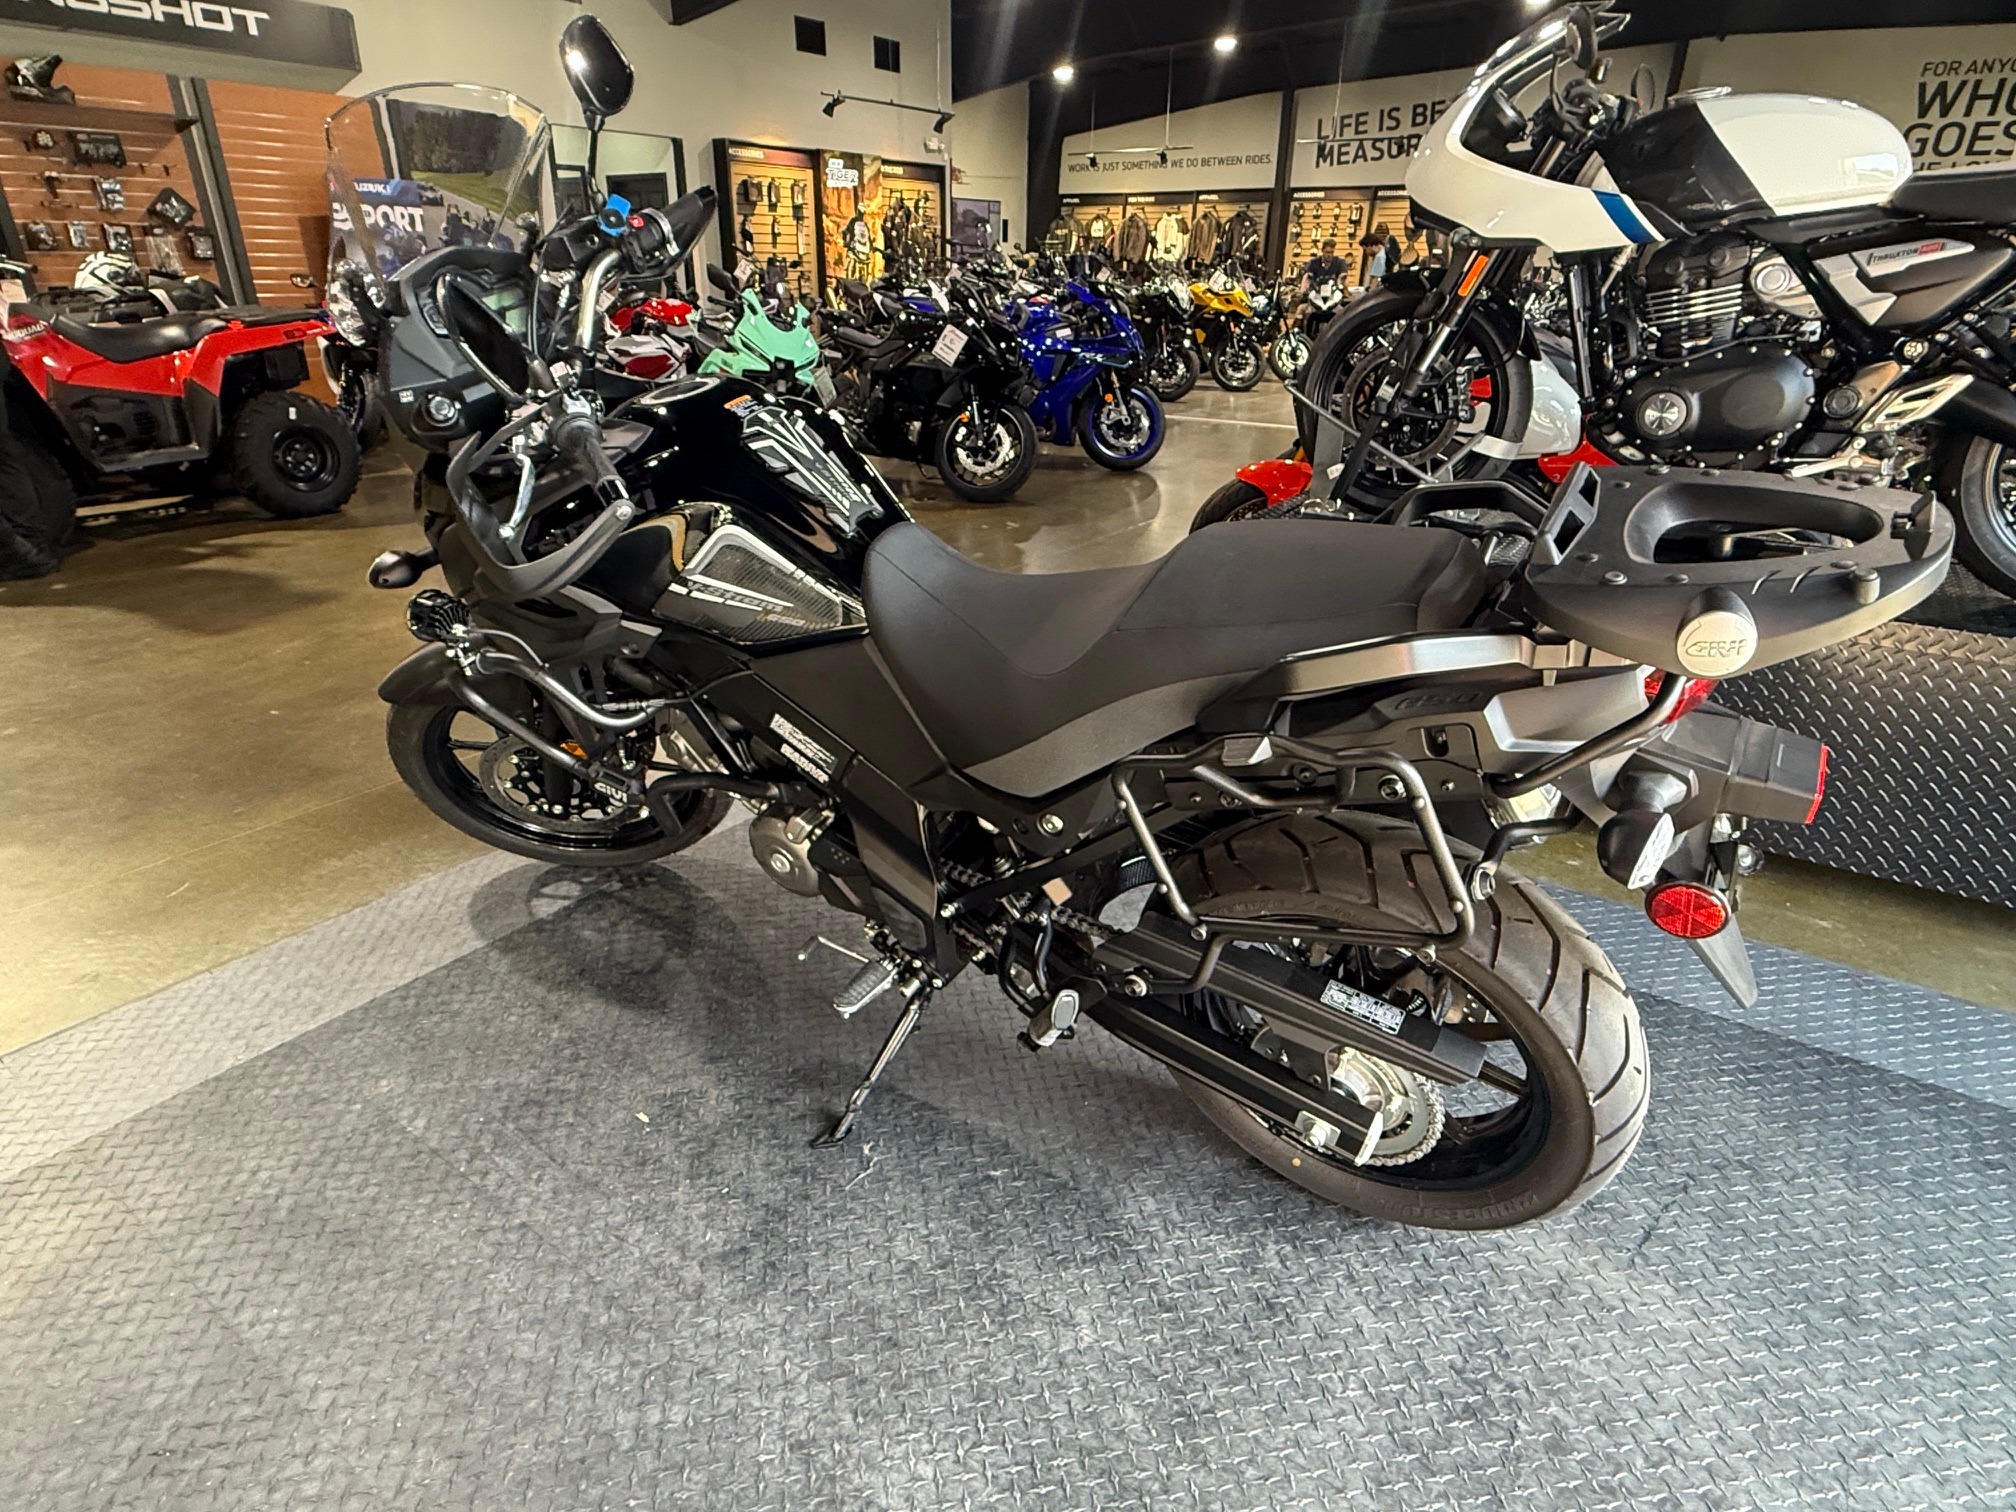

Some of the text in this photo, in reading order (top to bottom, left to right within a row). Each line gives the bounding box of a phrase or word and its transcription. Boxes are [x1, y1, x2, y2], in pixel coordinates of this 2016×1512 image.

[46, 0, 270, 36] SHOT
[1921, 60, 1962, 77] FOR
[1317, 99, 1446, 140] LIFE IS BE
[1903, 119, 2016, 158] GOES
[1315, 133, 1423, 168] MEASUR
[1068, 163, 1090, 172] WORK
[1102, 161, 1120, 172] JUST
[1171, 158, 1184, 168] WE
[1186, 157, 1199, 168] DO
[1201, 155, 1242, 167] BETWEEN
[353, 181, 391, 193] UZUKI
[1872, 248, 1920, 262] THRUXTON
[1686, 638, 1747, 658] GIVI
[594, 782, 628, 803] GIVI
